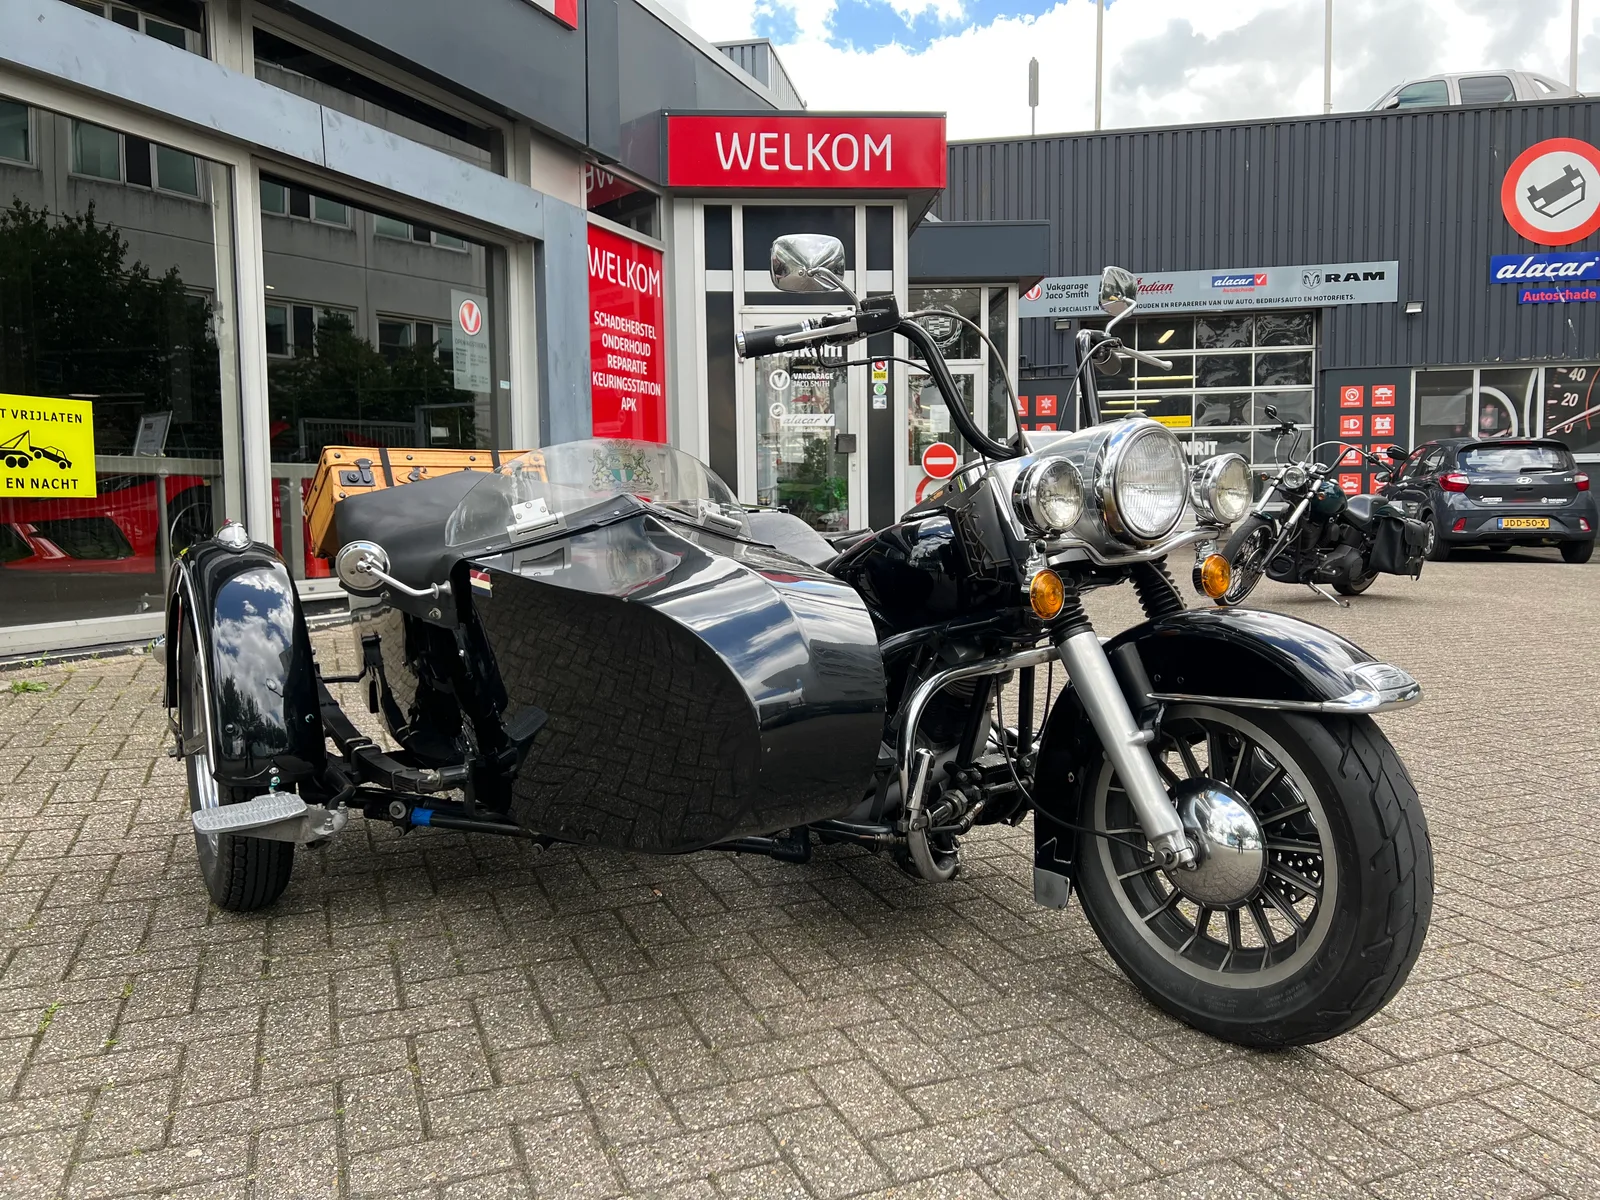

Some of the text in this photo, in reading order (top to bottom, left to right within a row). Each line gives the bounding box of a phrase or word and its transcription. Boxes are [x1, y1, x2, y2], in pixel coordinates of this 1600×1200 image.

[715, 132, 892, 171] WELKOM
[587, 244, 661, 297] WELKOM
[1496, 256, 1595, 279] alacar
[1214, 277, 1253, 286] alacar
[1325, 271, 1385, 283] RAM
[1046, 283, 1089, 292] Vakgarage
[1046, 290, 1089, 300] Jaco Smith
[1523, 289, 1597, 301] Autoschade
[594, 311, 657, 340] SCHADEHERSTEL
[602, 333, 651, 356] ONDERHOUD
[607, 354, 648, 375] REPARATIE
[793, 372, 834, 380] VAKGARAGE
[1569, 368, 1586, 381] 40
[592, 371, 661, 396] KEURINGSSTATION
[621, 397, 637, 411] APK
[1561, 393, 1578, 406] 20
[11, 409, 82, 423] VRIJLATEN
[1180, 441, 1218, 455] NRIT
[6, 478, 78, 489] EN NACHT
[1504, 519, 1546, 527] JDD-50-X
